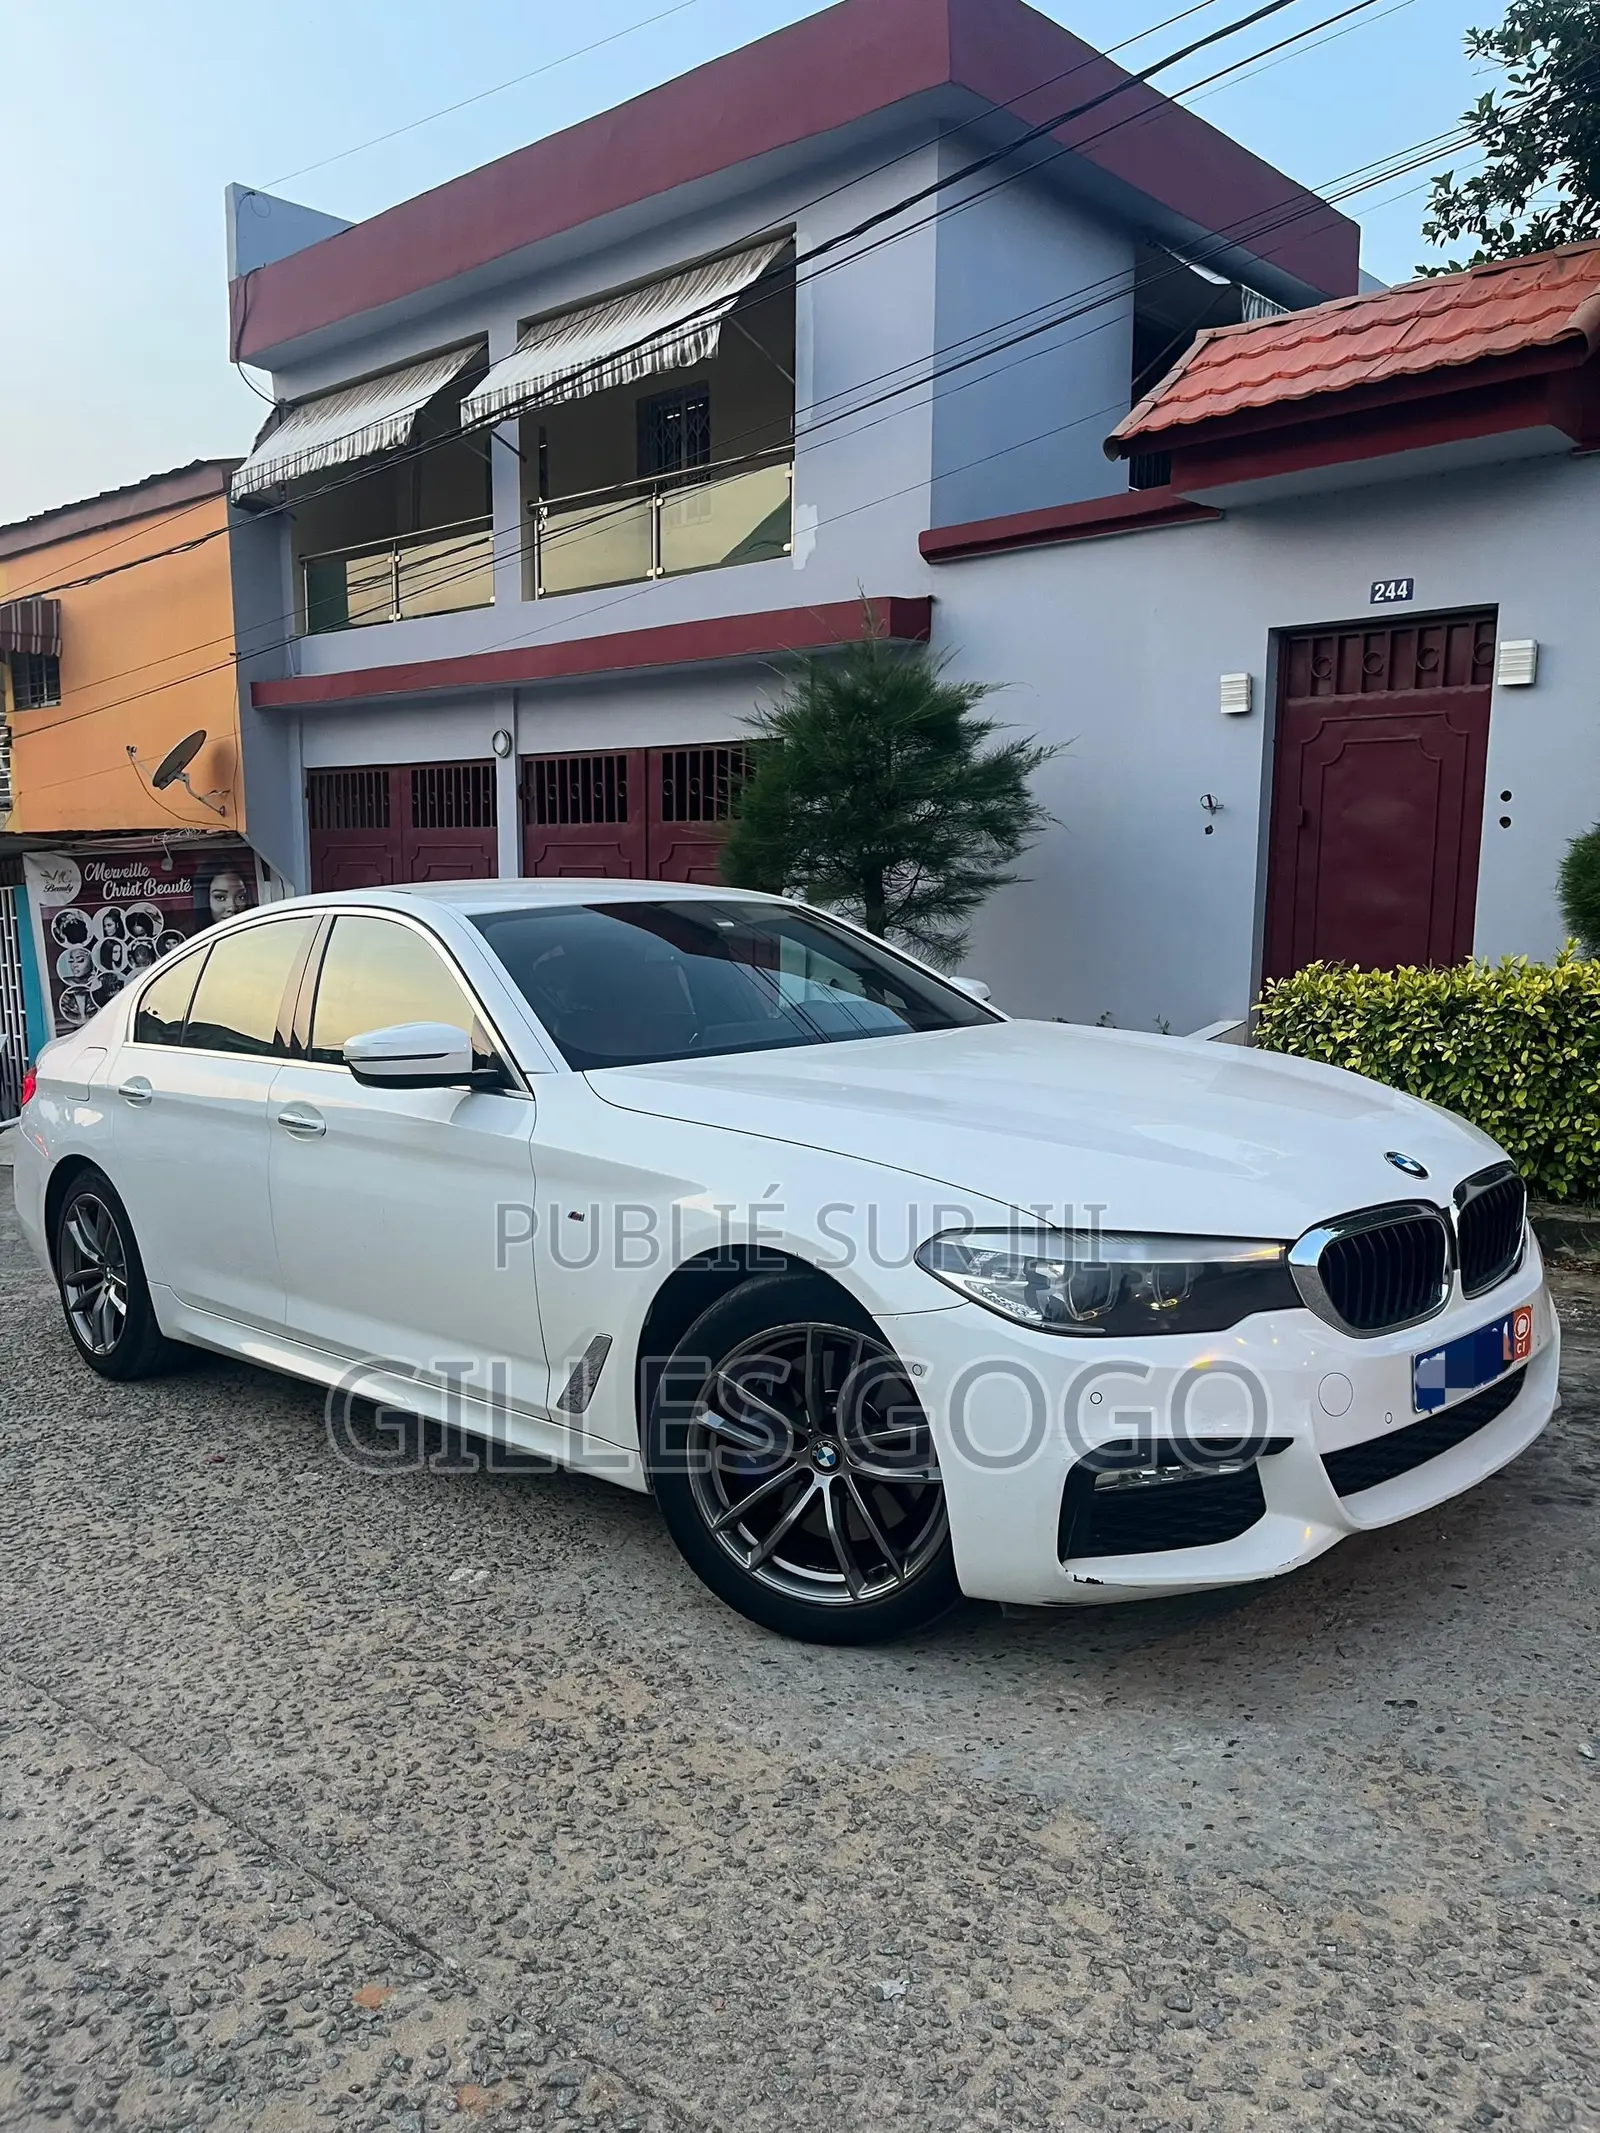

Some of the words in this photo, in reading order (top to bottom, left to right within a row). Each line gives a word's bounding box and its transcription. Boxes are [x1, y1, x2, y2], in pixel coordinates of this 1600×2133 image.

[1374, 580, 1408, 601] 244
[84, 862, 150, 882] Merveille
[43, 883, 75, 893] Beauty
[102, 878, 142, 900] Christ
[143, 878, 192, 897] Beauté
[1516, 1340, 1526, 1354] CI
